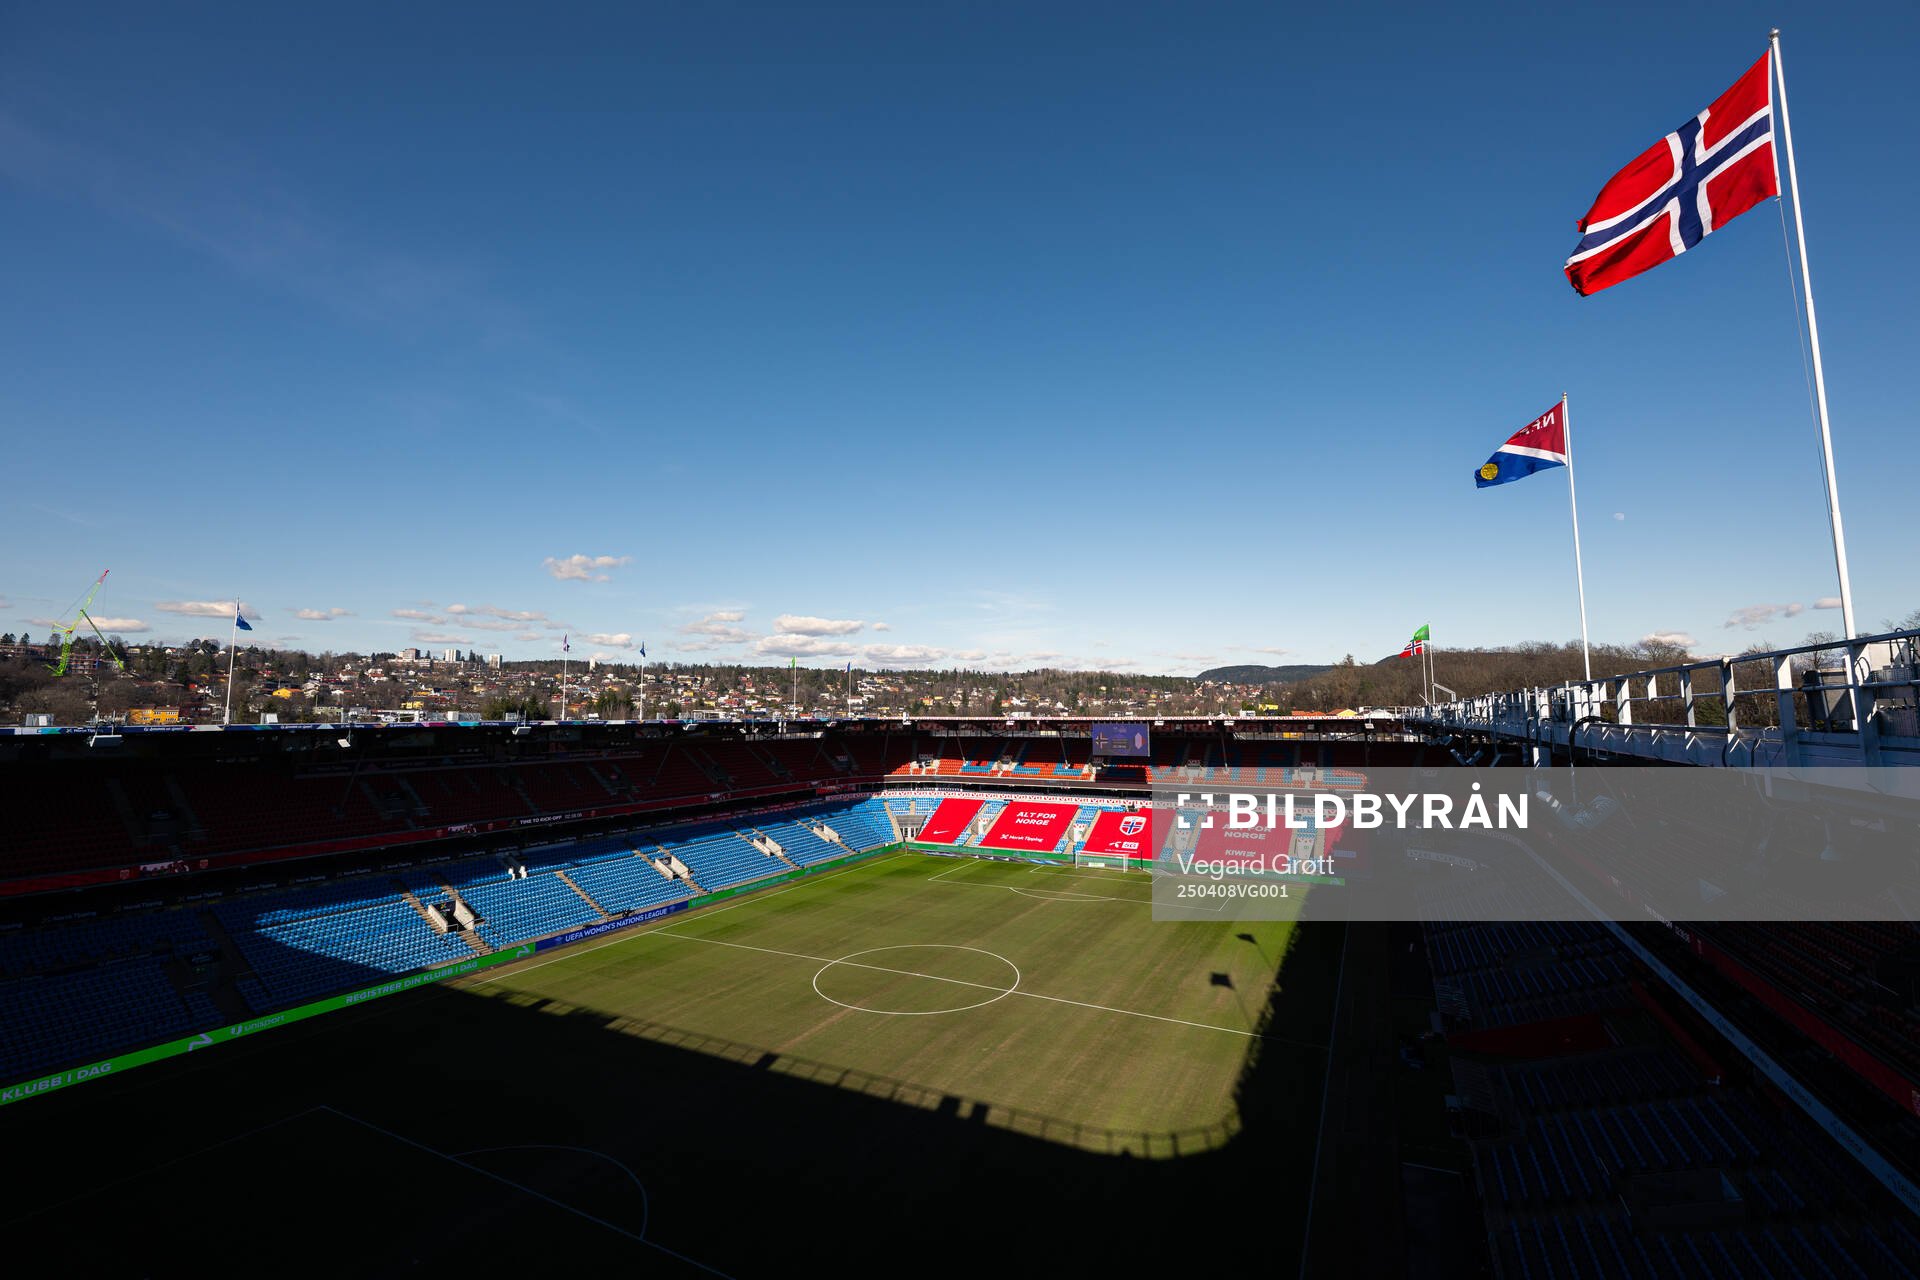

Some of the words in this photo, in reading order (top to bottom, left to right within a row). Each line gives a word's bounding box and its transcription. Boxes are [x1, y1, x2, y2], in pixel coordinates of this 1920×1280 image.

[1016, 818, 1050, 826] NORGE
[1036, 812, 1057, 820] FOR
[1224, 832, 1266, 840] NORGE
[566, 932, 584, 942] UEFA
[584, 922, 616, 936] WOMEN'S
[616, 915, 644, 929] NATIONS
[644, 908, 668, 922] LEAGUE
[346, 982, 402, 1004] REGISTRER
[404, 976, 421, 990] DIN
[423, 968, 453, 982] KLUBB
[460, 961, 478, 970] DAG
[244, 1015, 285, 1032] unisport
[2, 1076, 62, 1102] KLUBB
[67, 1072, 72, 1083] I
[77, 1062, 112, 1080] DAG
